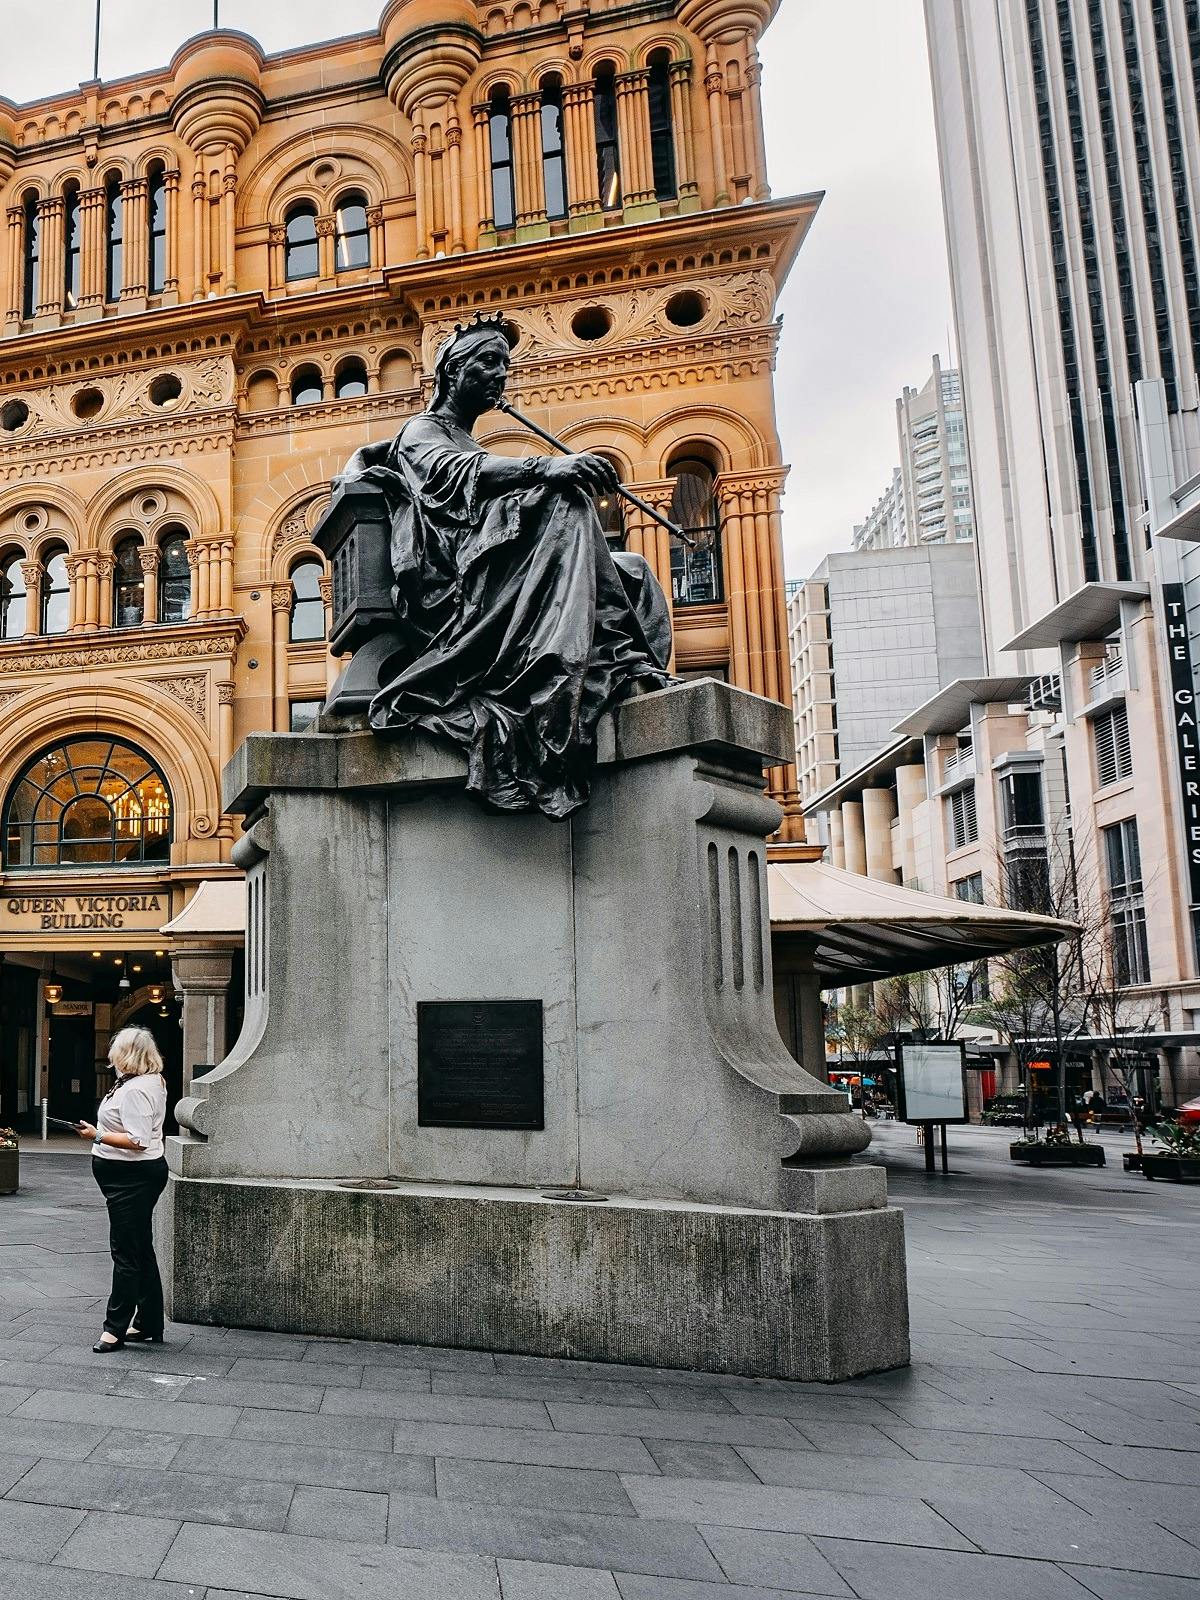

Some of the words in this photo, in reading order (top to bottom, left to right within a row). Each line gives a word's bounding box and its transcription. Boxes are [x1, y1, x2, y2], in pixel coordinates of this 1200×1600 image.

[1168, 602, 1186, 660] THE
[1174, 689, 1200, 864] GALERIES
[7, 899, 66, 914] QUEEN
[75, 896, 161, 912] VICTORIA
[40, 913, 124, 929] BUILDING
